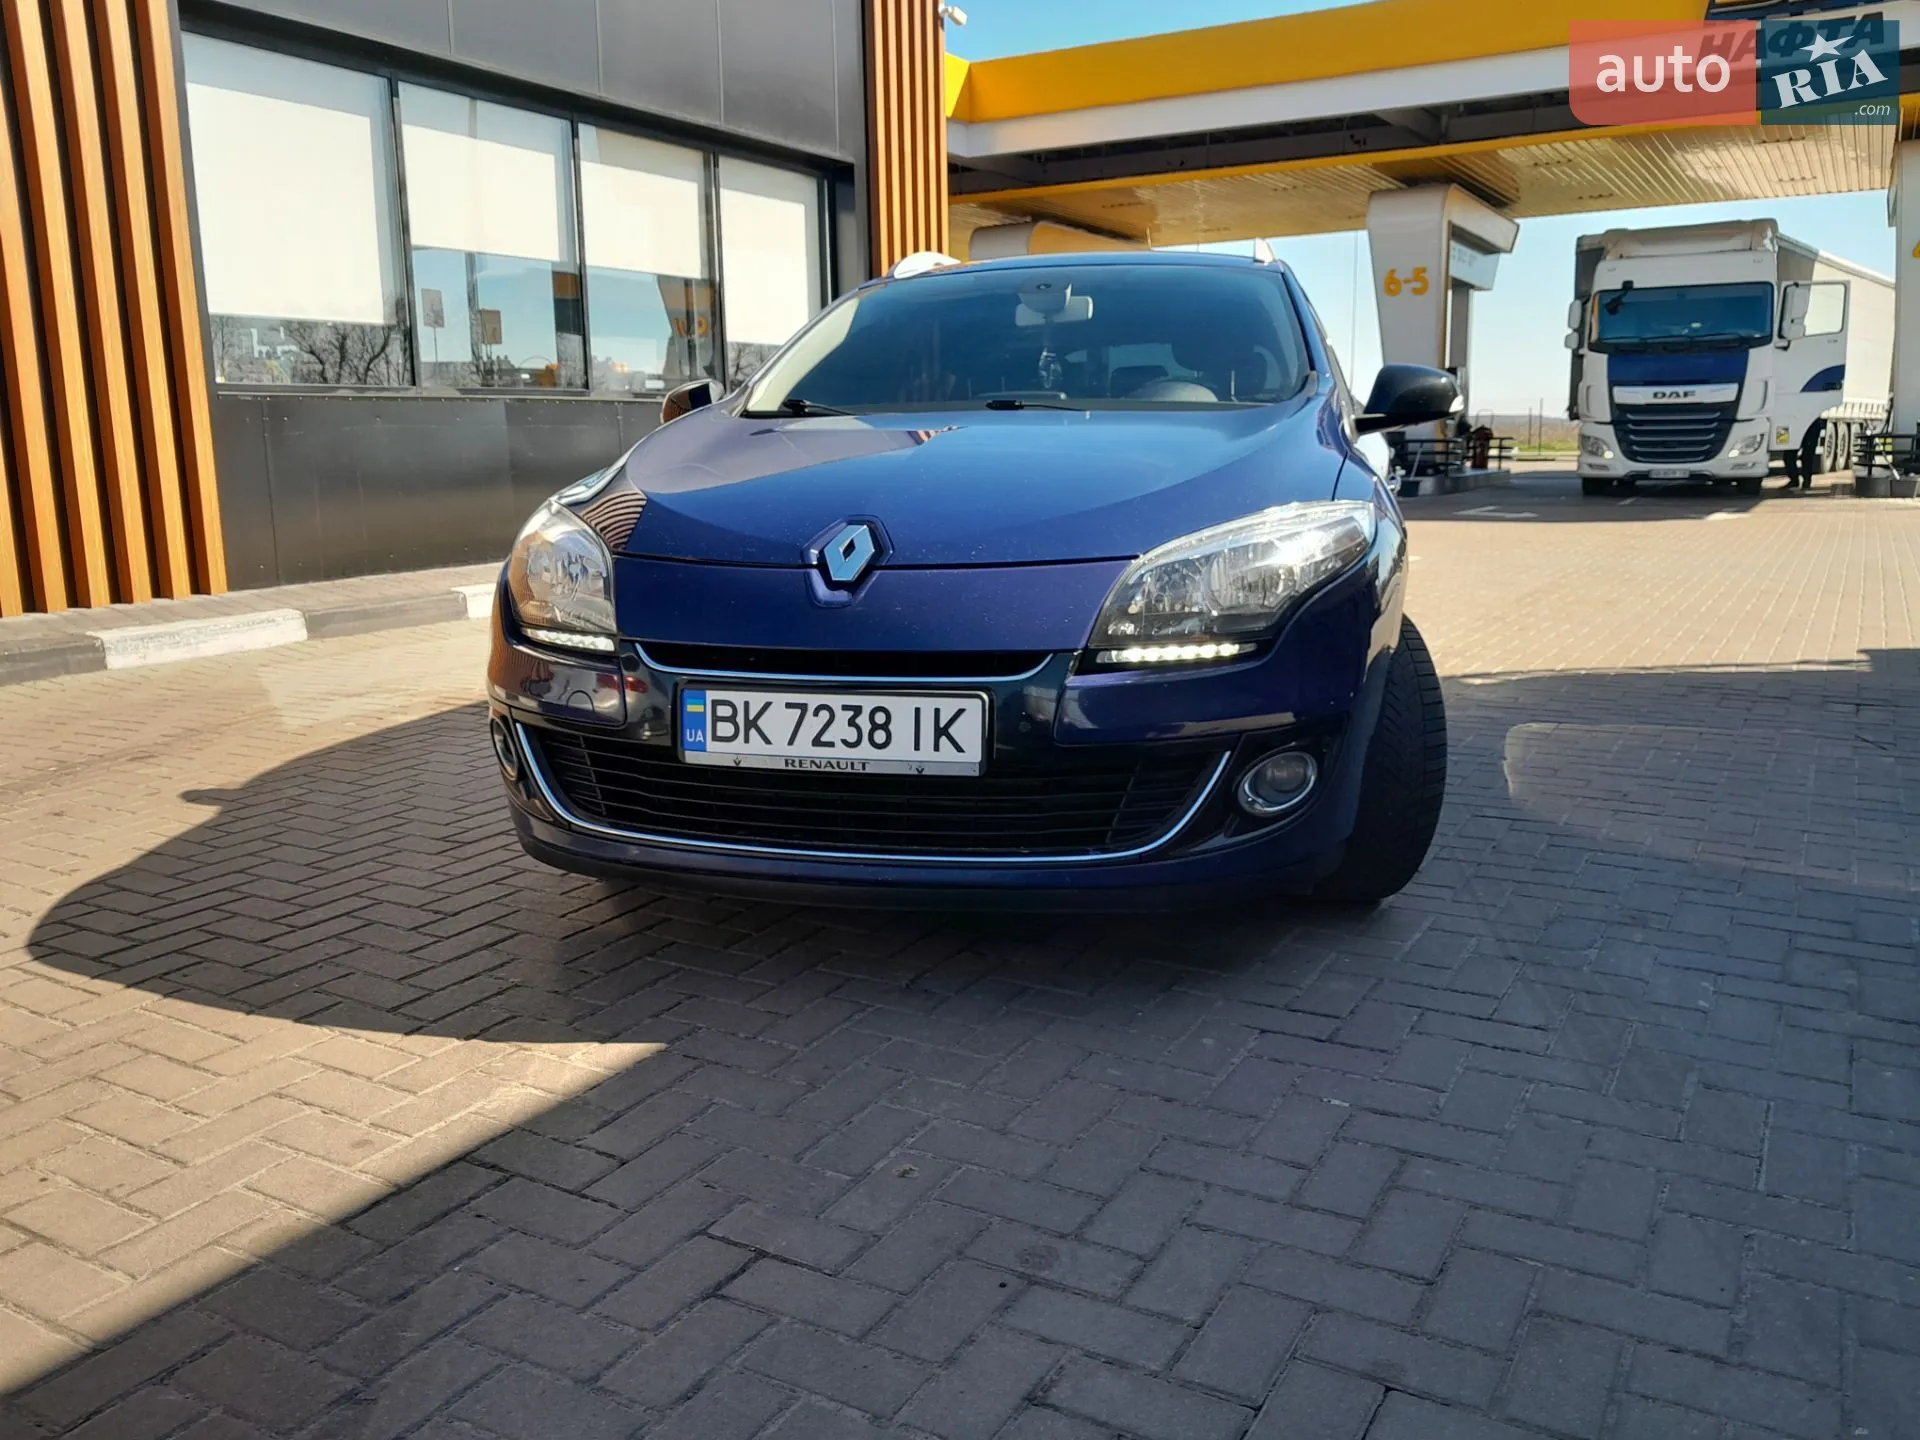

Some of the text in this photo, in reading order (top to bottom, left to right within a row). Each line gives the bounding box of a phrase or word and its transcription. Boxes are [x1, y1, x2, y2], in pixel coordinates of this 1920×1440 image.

[1383, 267, 1429, 297] 6-5
[1653, 390, 1696, 399] DAF
[711, 699, 967, 753] BK 7238 IK
[686, 729, 704, 742] UA
[784, 758, 870, 771] RENAULT
